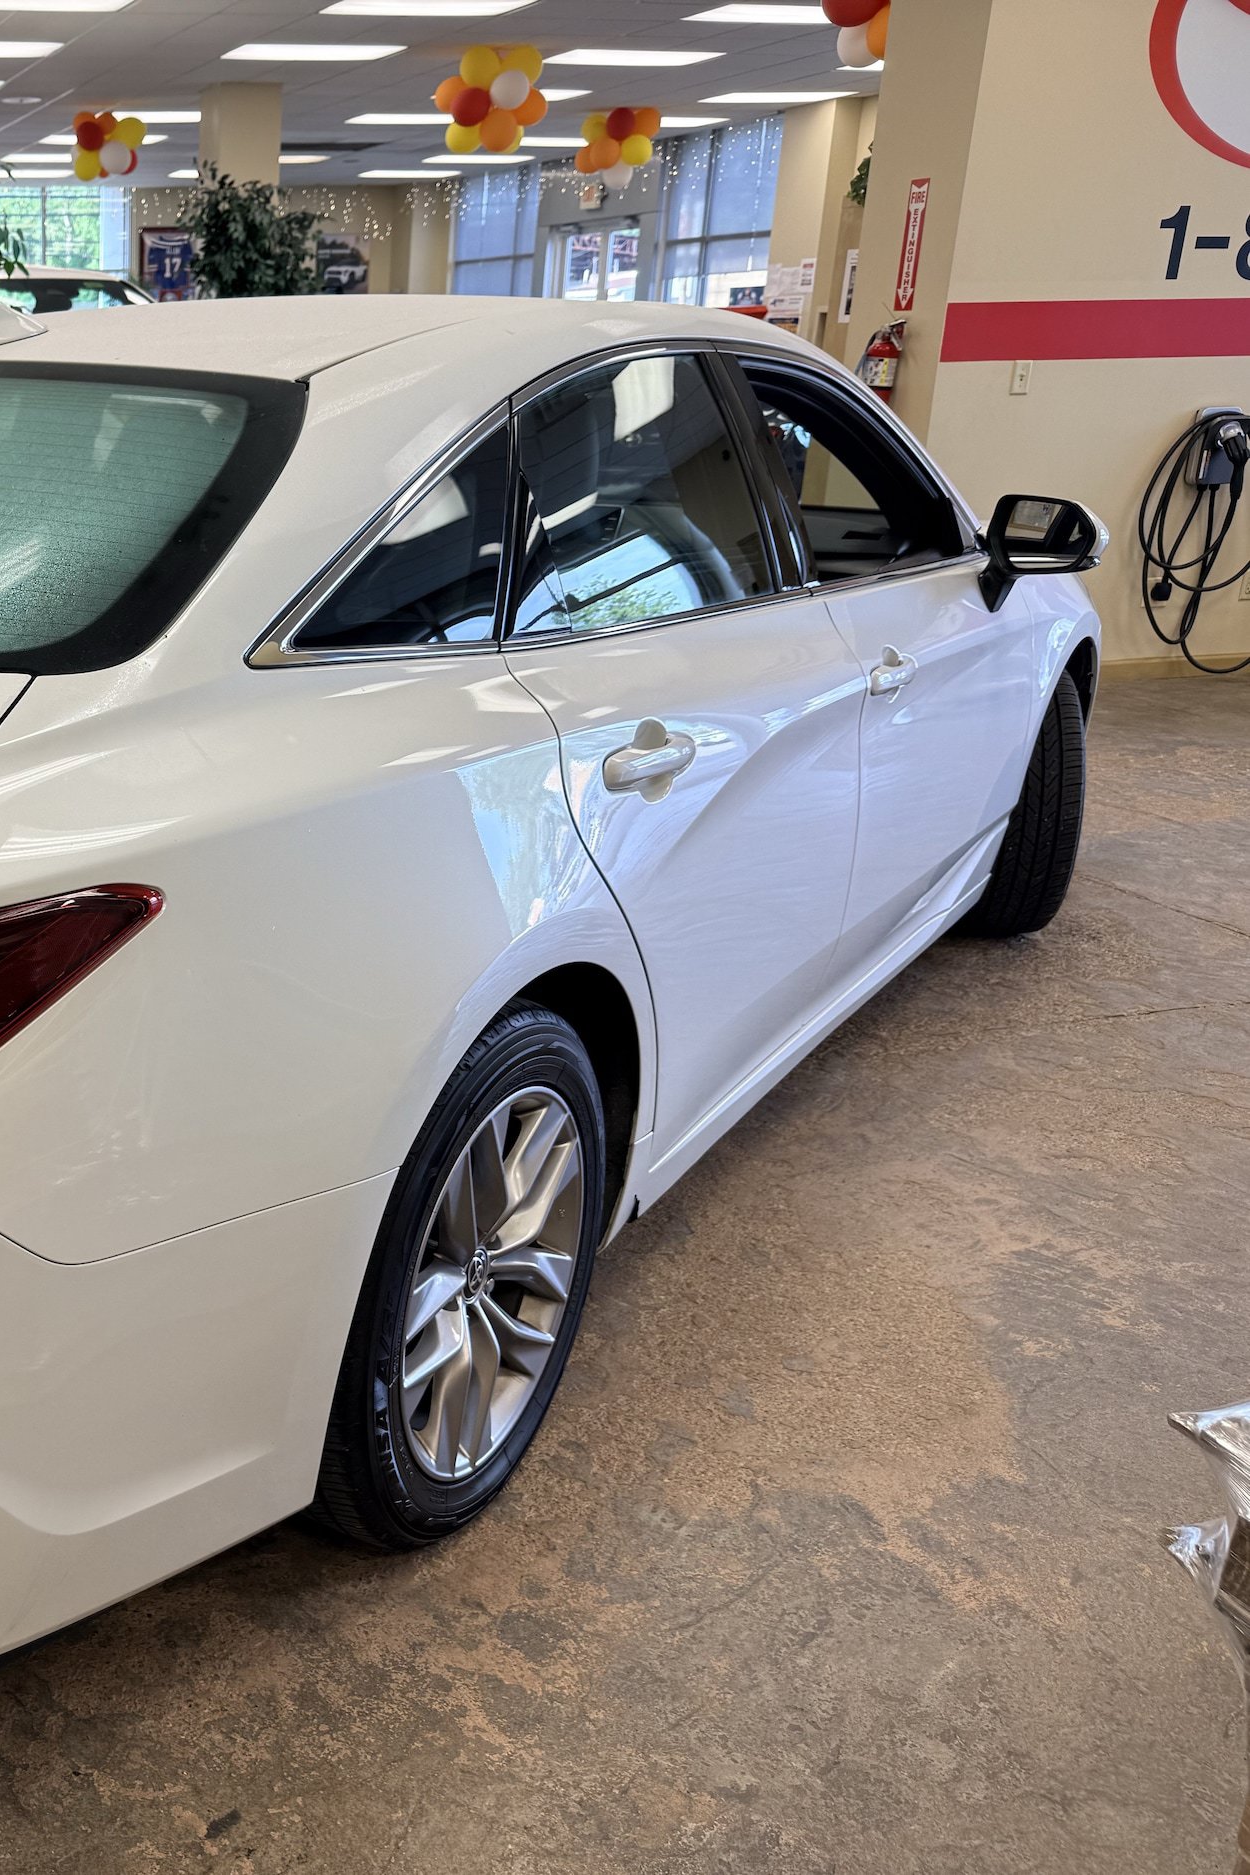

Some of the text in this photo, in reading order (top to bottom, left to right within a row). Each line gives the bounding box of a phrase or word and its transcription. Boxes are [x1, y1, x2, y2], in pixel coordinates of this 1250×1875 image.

[911, 191, 926, 204] FIRE
[902, 208, 919, 301] EXTINGUISHER
[163, 257, 182, 279] 17
